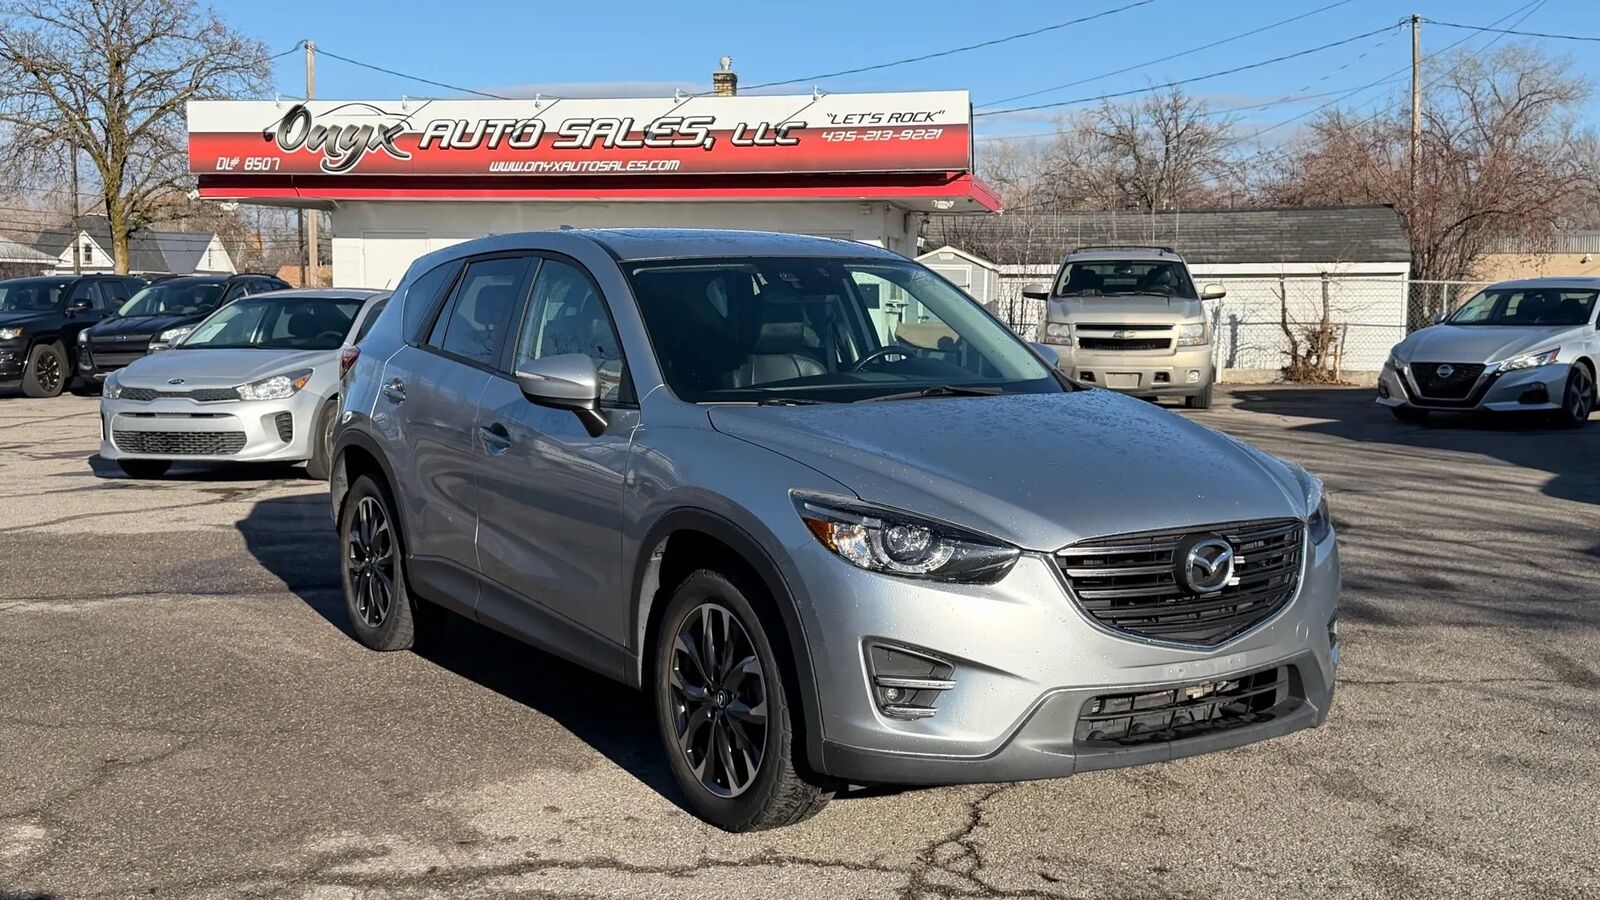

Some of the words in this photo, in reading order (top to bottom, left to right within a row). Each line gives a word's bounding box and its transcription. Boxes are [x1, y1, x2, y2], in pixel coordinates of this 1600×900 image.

[887, 109, 946, 124] ROCK"
[277, 103, 411, 172] Onyx
[418, 118, 547, 149] AUTO
[552, 115, 716, 151] SALES,
[731, 121, 807, 146] LLC
[821, 128, 944, 142] 435-213-9221
[215, 156, 240, 171] DL#
[244, 156, 281, 171] 8507
[489, 159, 681, 172] WWW.ONYXAUTOSALES.COM
